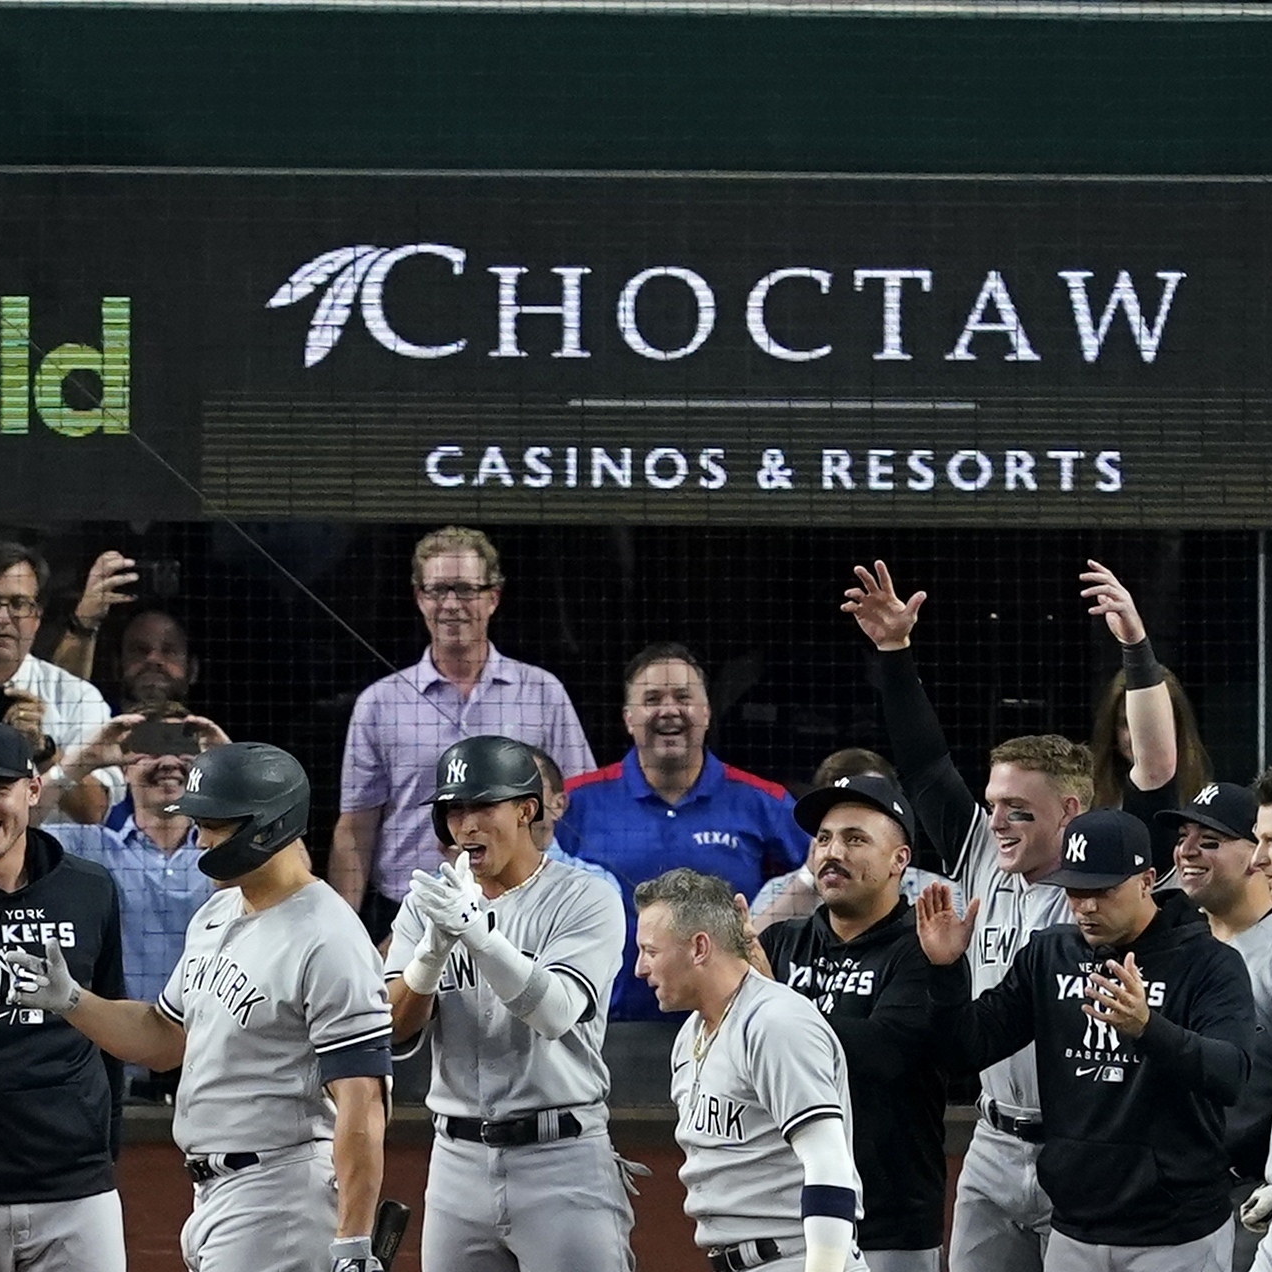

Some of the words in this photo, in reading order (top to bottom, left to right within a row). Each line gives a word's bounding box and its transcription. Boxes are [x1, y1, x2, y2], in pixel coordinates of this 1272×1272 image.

[424, 446, 727, 491] CASINOS
[757, 448, 793, 492] &
[821, 450, 1126, 494] RESORTS
[692, 831, 739, 849] TEXAS
[5, 908, 46, 920] YORK
[208, 954, 267, 1029] YORK
